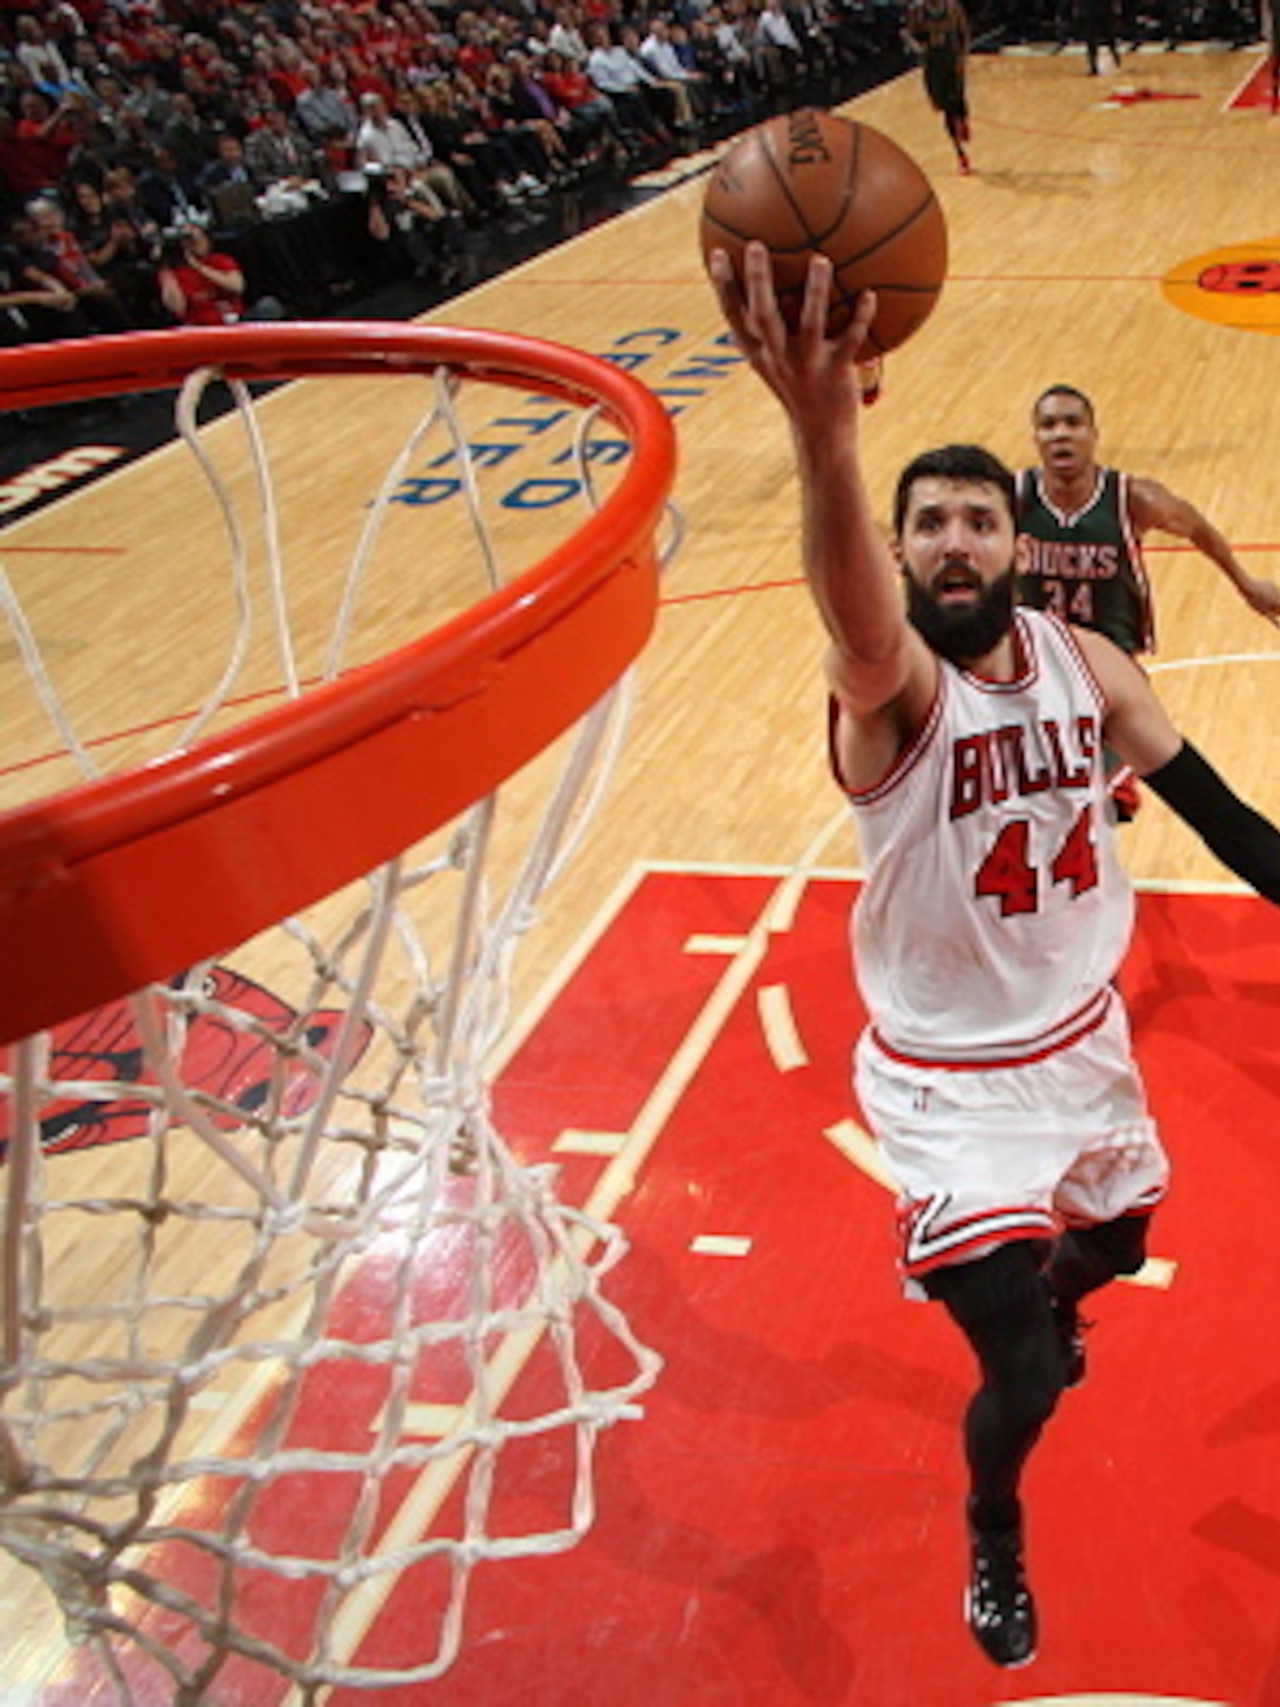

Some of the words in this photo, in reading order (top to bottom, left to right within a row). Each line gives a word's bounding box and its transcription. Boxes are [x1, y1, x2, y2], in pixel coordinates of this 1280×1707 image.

[388, 327, 682, 505] CETER
[499, 331, 746, 509] NIED
[1041, 579, 1094, 623] 34
[949, 716, 1097, 824] BULLS
[974, 802, 1099, 918] 44
